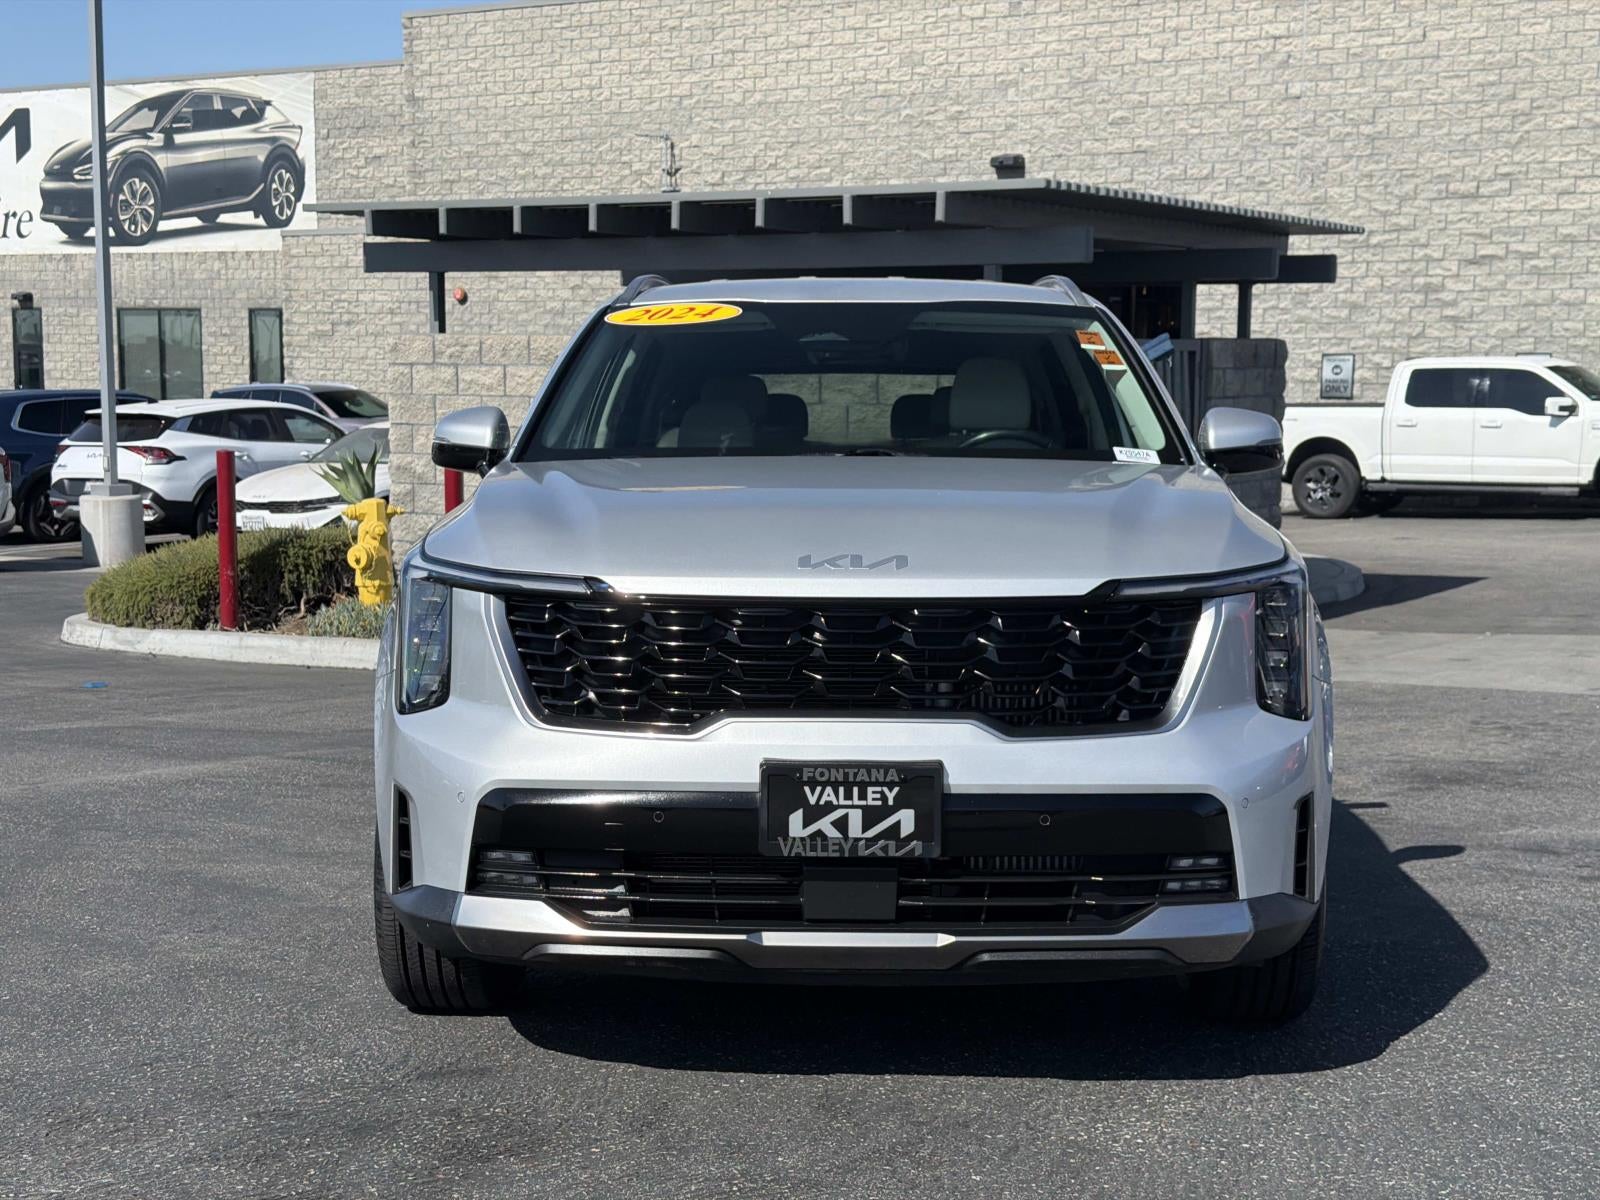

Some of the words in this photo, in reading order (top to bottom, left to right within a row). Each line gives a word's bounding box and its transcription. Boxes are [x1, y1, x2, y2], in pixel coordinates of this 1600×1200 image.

[0, 209, 34, 239] re
[624, 307, 723, 322] 2024
[1325, 384, 1349, 393] ONLY
[798, 554, 909, 570] KIA
[802, 768, 900, 782] FONTANA
[803, 786, 901, 806] VALLEY
[788, 808, 915, 839] KIA
[777, 836, 855, 857] VALLEY
[858, 839, 923, 857] KIA
